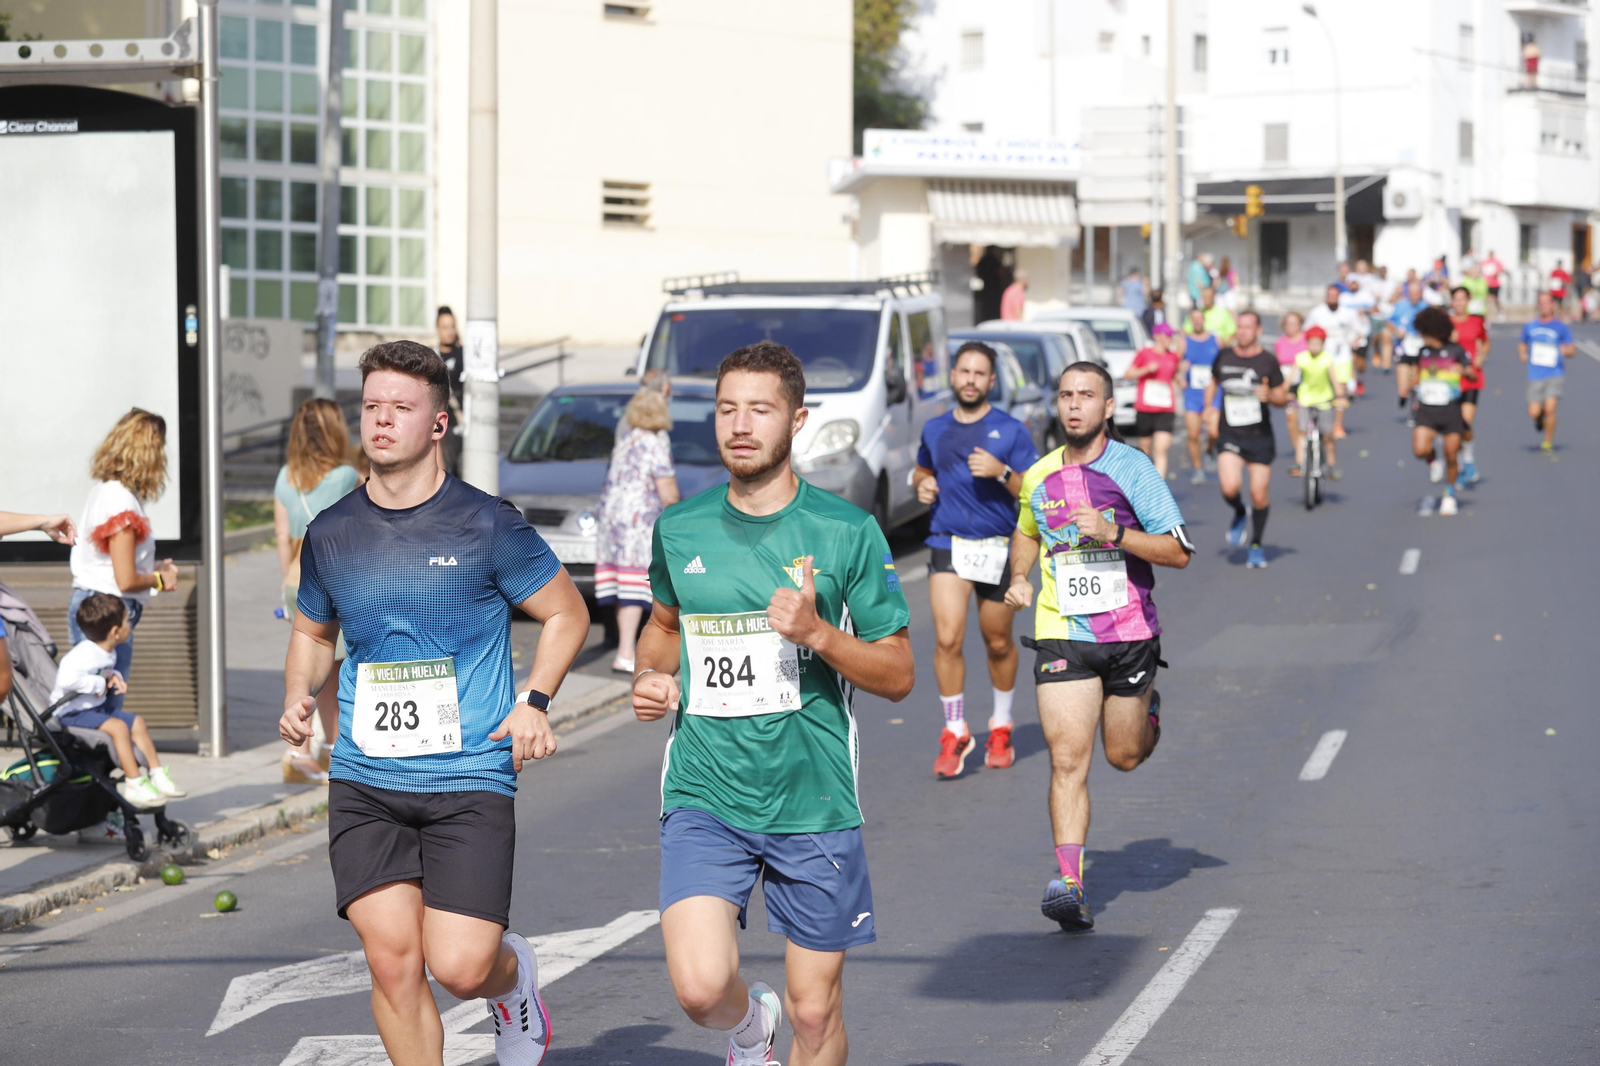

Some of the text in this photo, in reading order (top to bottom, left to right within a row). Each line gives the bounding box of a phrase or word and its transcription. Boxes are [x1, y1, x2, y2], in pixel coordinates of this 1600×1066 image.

[8, 120, 78, 133] Clear Channel
[995, 140, 1081, 151] CHOCOLA
[916, 151, 1069, 166] PATATAS FRITAS
[429, 556, 458, 566] FILA
[963, 553, 989, 568] 527
[1066, 553, 1089, 564] VUELTA
[1089, 553, 1095, 563] A
[1095, 551, 1120, 562] HUELVA
[684, 566, 706, 574] adidas
[1068, 575, 1102, 598] 586
[690, 617, 772, 634] 34 VUELTA A HUEL
[701, 636, 745, 646] JOSÉ MARÍA
[402, 667, 409, 680] A
[411, 664, 448, 679] HUELVA
[704, 655, 756, 689] 284
[375, 700, 419, 731] 283
